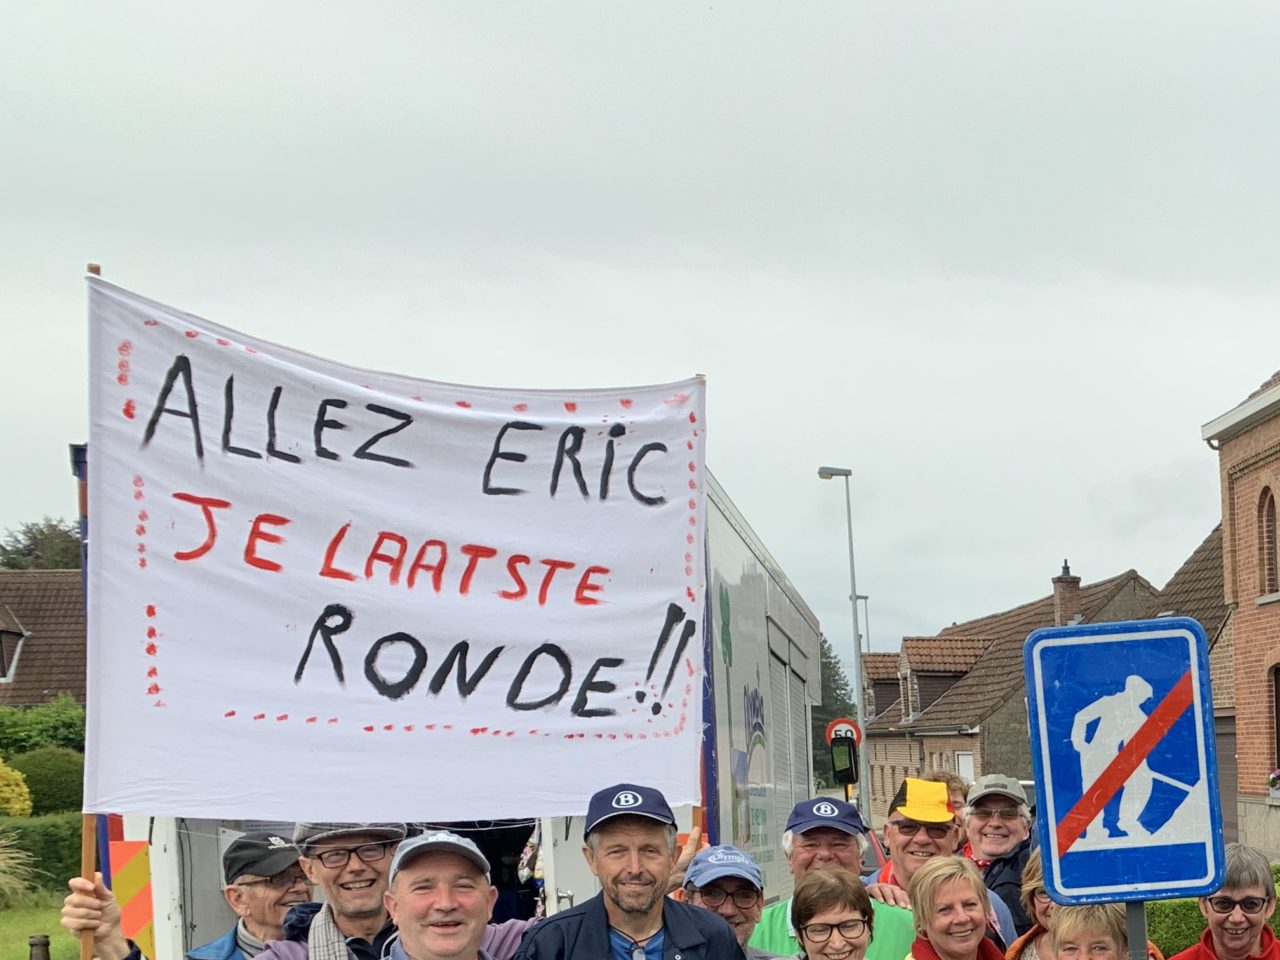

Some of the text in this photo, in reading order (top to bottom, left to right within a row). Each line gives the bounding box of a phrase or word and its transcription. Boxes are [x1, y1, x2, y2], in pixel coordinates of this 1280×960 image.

[142, 354, 415, 468] ALLEZ
[172, 492, 611, 607] JE LAATSTE
[293, 602, 697, 718] RONDE!!
